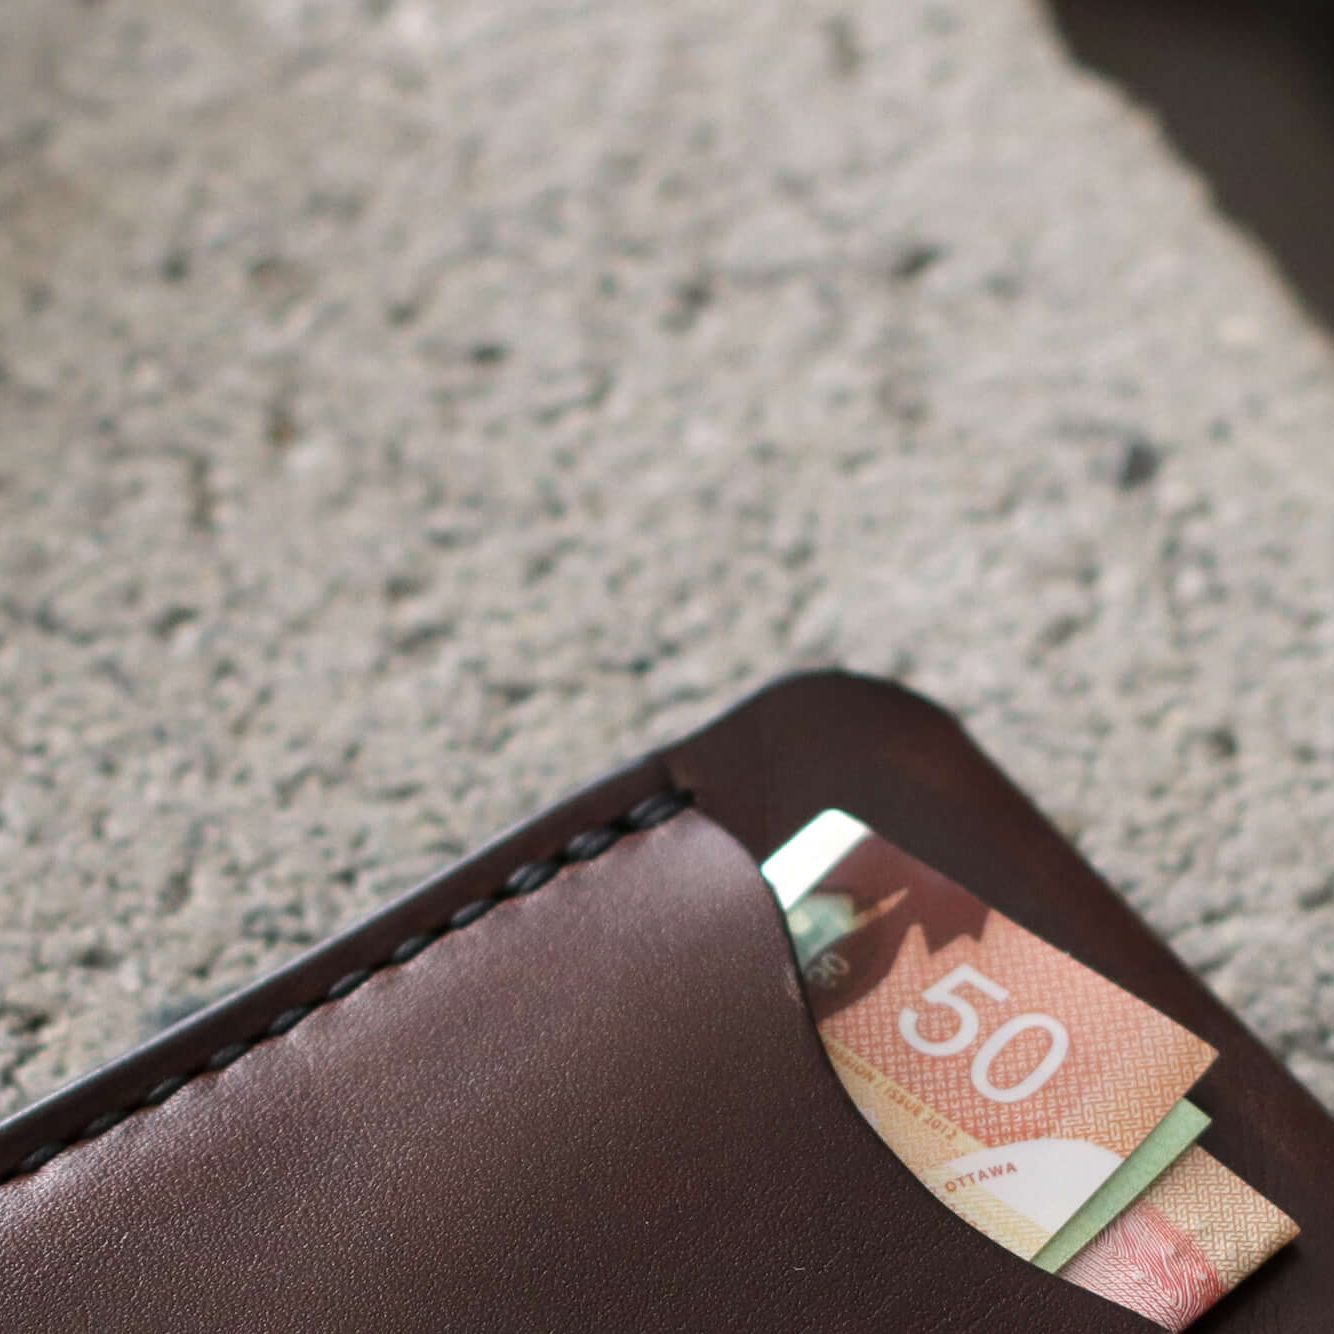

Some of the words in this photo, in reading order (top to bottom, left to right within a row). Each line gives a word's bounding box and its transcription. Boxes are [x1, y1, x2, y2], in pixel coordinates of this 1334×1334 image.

[899, 963, 1069, 1103] 50
[883, 1086, 923, 1117] ISSUE
[923, 1113, 957, 1141] 2012
[944, 1161, 1018, 1193] OTTAWA
